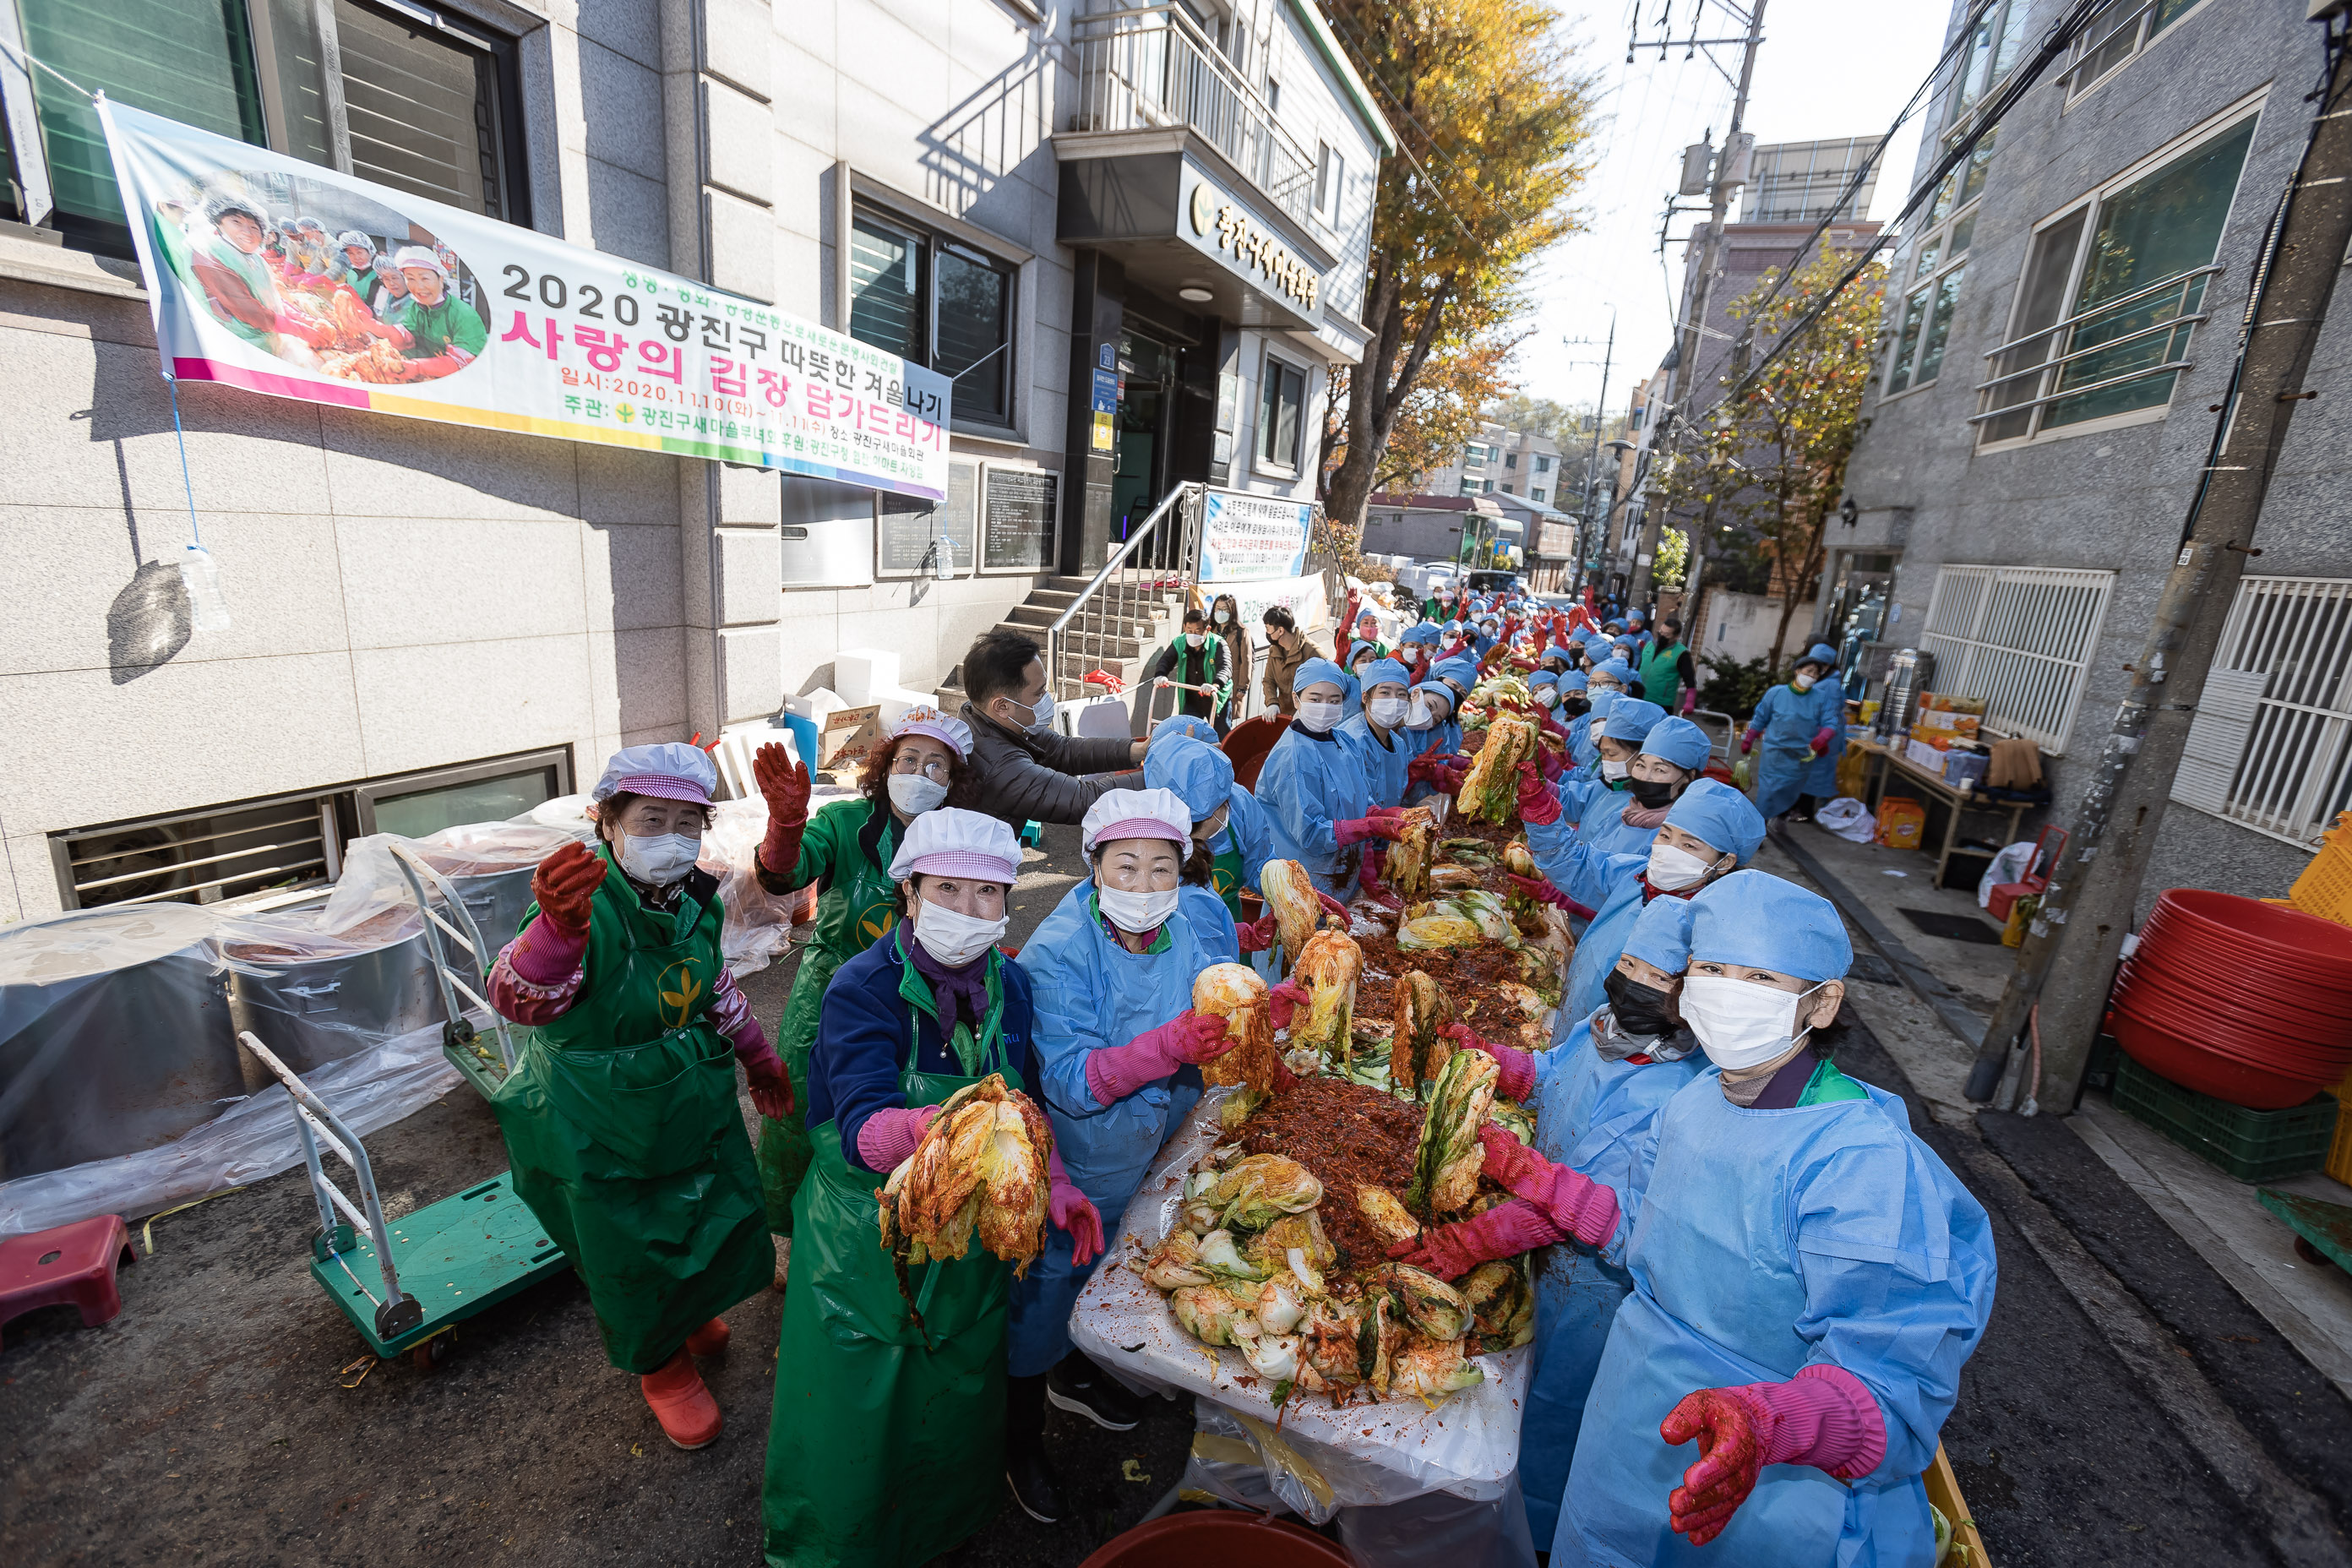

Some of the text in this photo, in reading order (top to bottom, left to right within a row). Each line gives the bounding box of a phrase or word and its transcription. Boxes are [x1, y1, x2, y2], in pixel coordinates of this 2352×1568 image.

[1217, 206, 1319, 312] 광진구새마을회관
[501, 310, 941, 451] 사랑의 김장 담가드리기
[503, 264, 942, 421] 2020 광진구 따뜻한 겨울나기
[564, 395, 608, 418] 주관:
[642, 406, 776, 444] 광진구새마을부녀회
